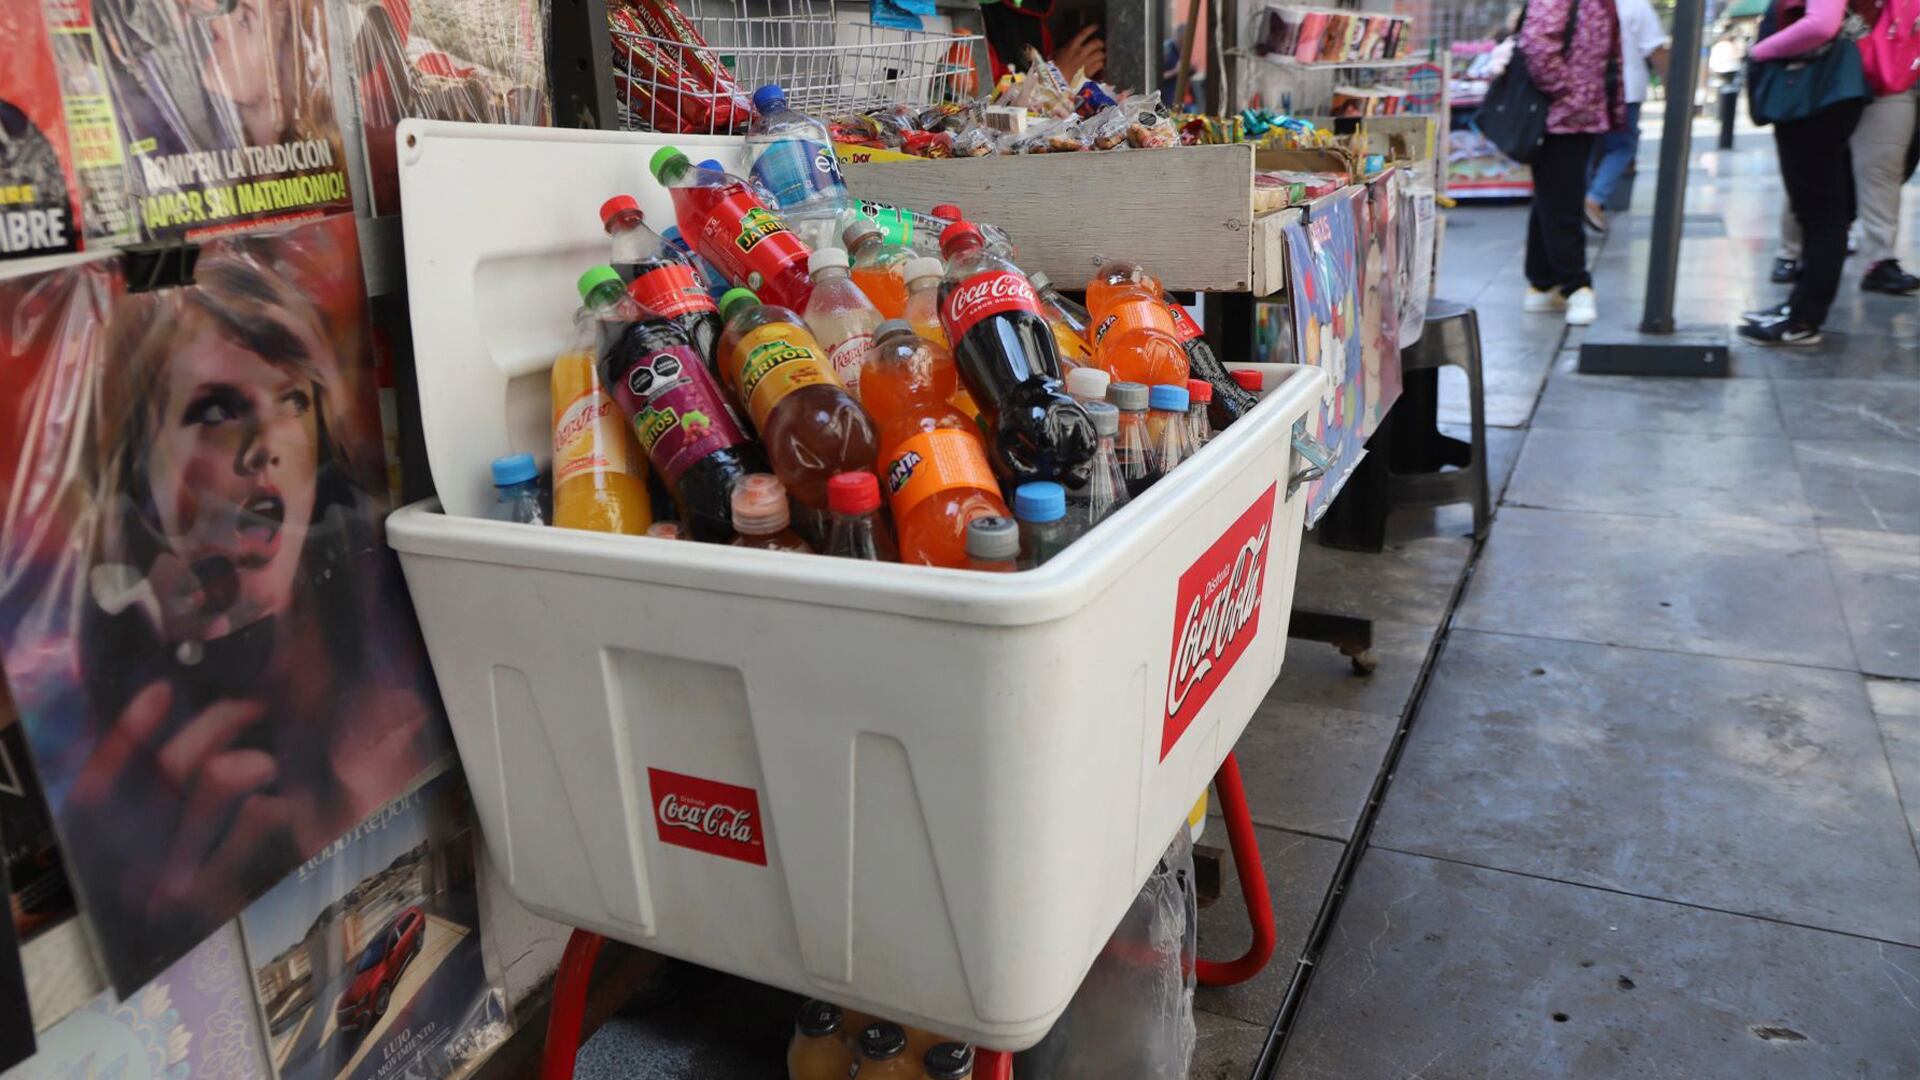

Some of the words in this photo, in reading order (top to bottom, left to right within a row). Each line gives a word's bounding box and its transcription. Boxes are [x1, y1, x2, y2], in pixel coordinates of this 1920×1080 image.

[141, 151, 222, 191] ROMPEN
[221, 147, 246, 180] LA
[243, 131, 334, 177] TRADICIÓN
[204, 185, 239, 219] SIN
[237, 171, 347, 215] MATRIMONIO!
[951, 274, 1033, 322] Coca-Cola
[1167, 518, 1270, 717] Coca-Cola
[658, 793, 753, 842] Coca-Cola
